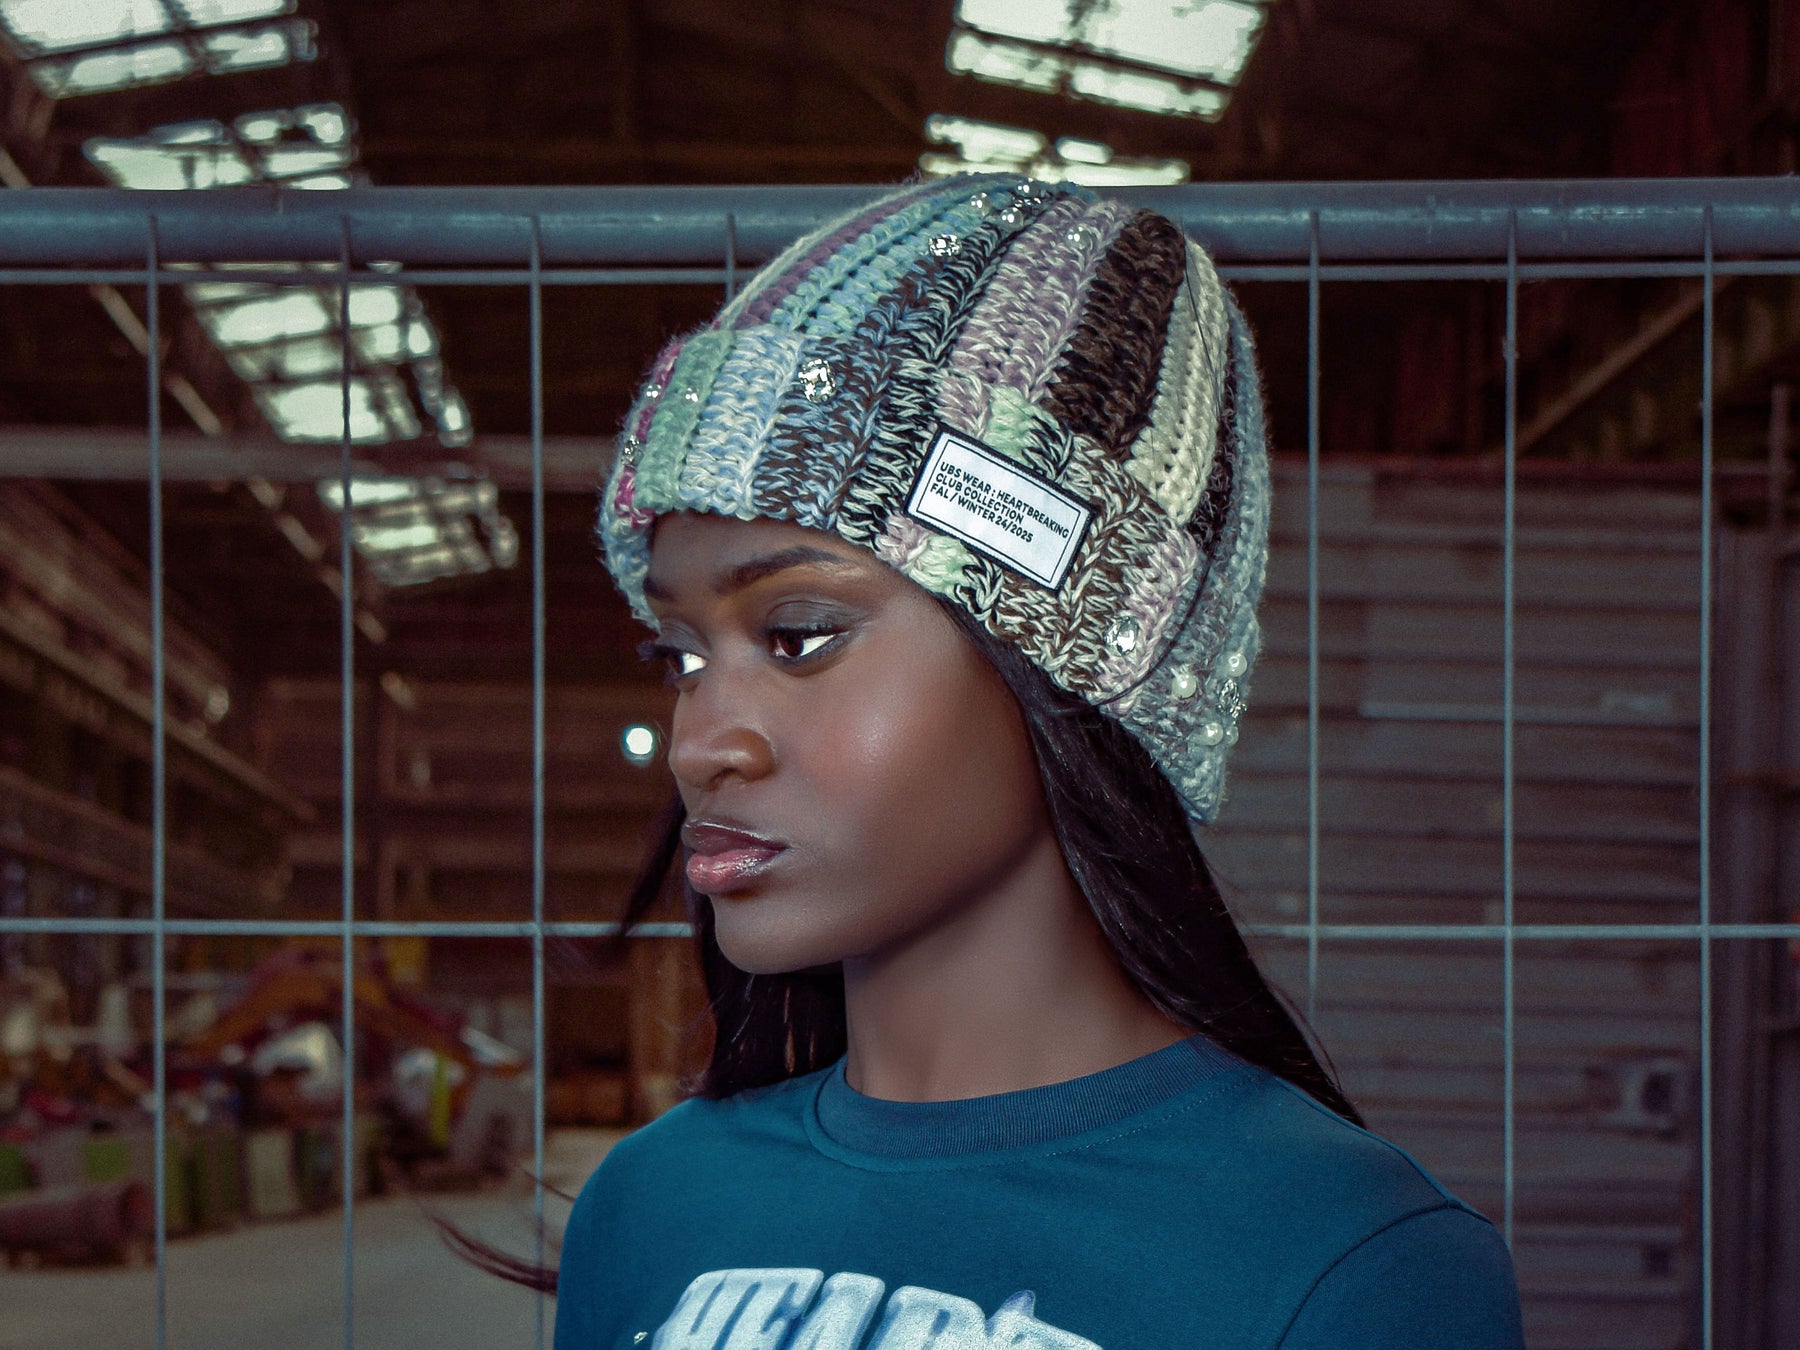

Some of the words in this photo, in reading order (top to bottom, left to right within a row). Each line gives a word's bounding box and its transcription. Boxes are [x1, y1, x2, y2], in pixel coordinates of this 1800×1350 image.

[930, 482, 949, 499] FAL
[995, 514, 1034, 543] 24/2025
[935, 473, 963, 492] CLUB
[964, 486, 1025, 524] COLLECTION
[940, 461, 962, 478] UBS
[962, 472, 991, 495] WEAR
[997, 489, 1070, 539] HEARTBREAKING
